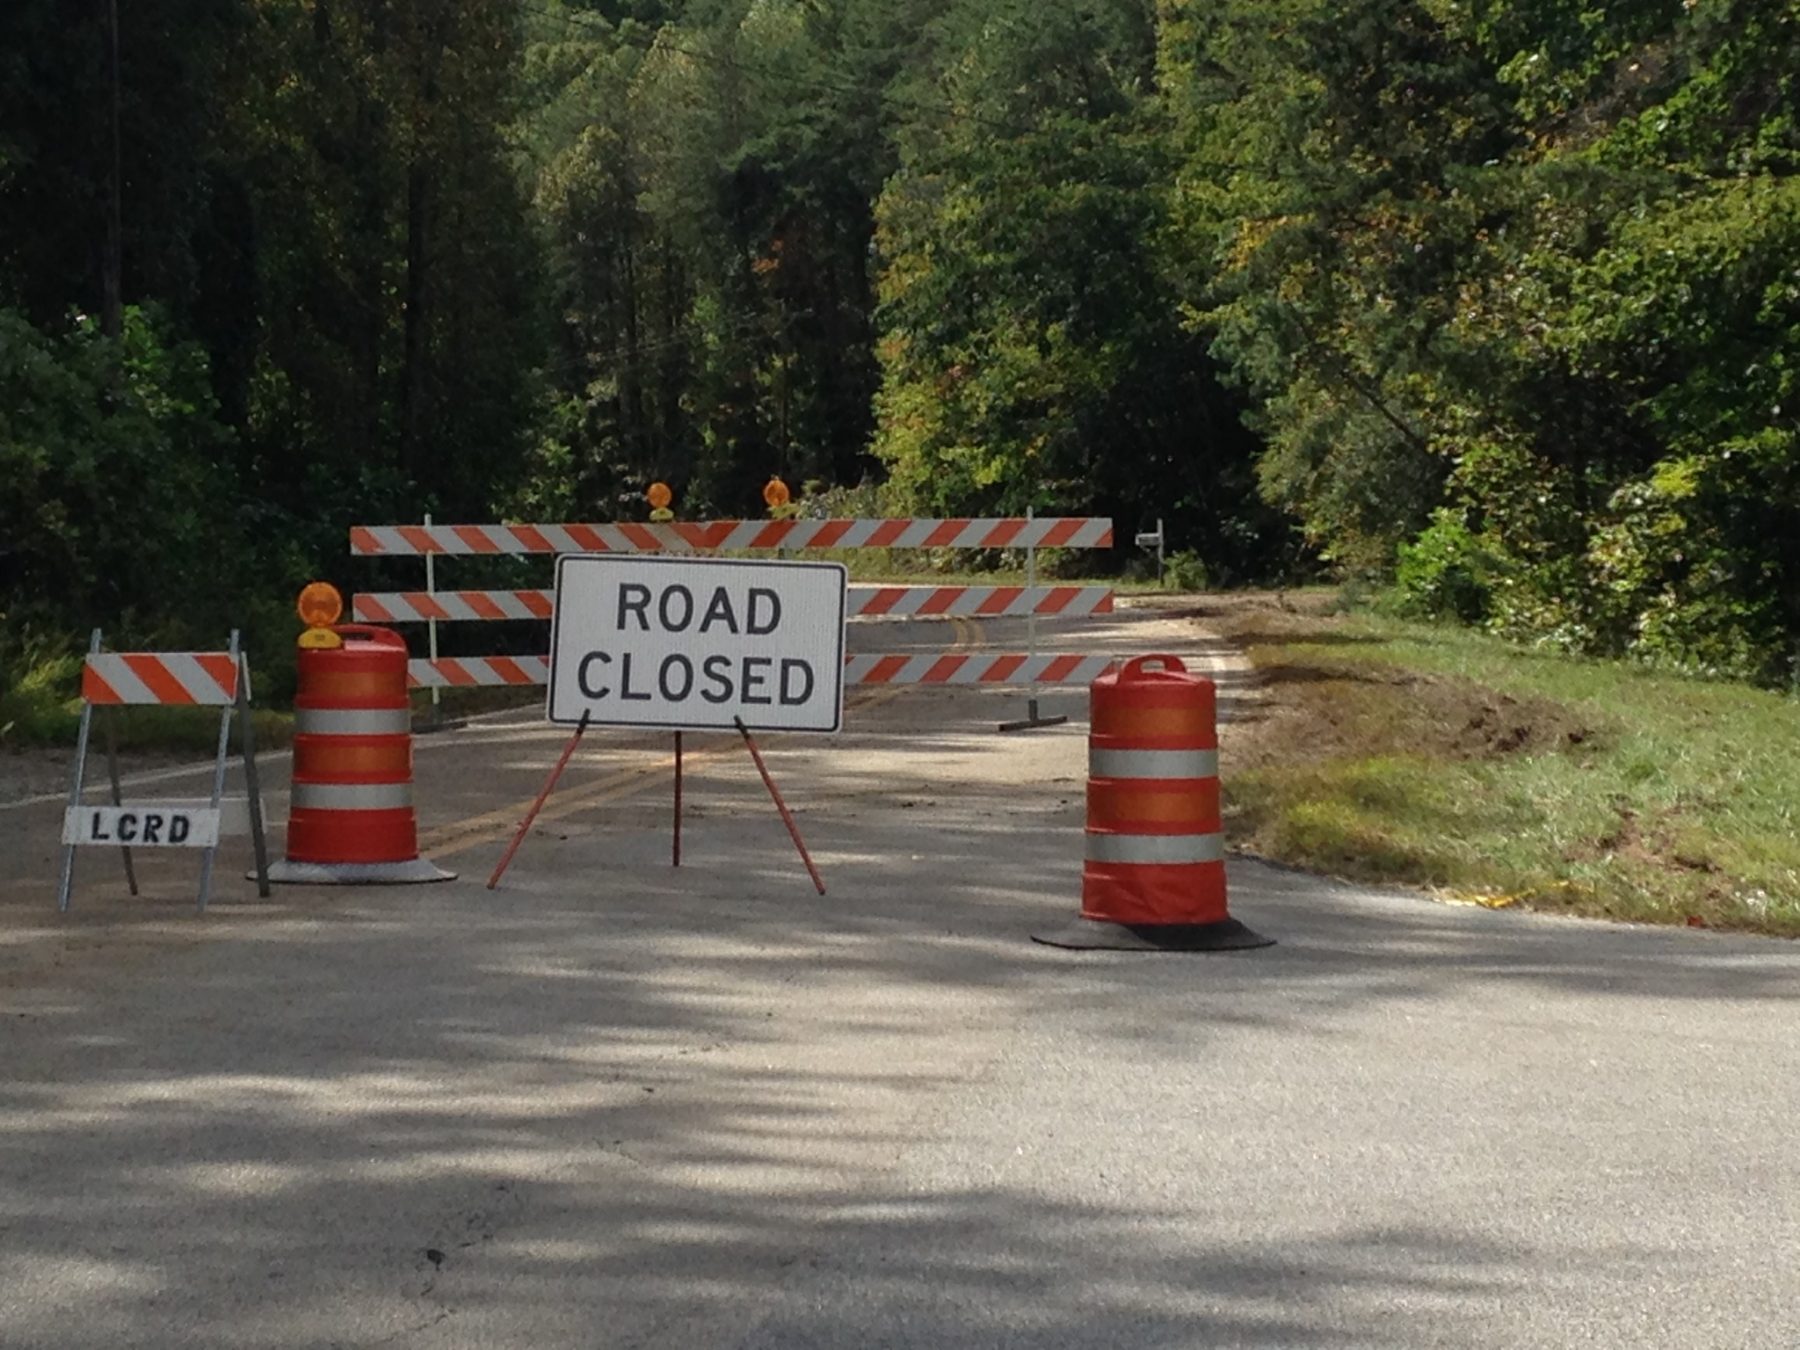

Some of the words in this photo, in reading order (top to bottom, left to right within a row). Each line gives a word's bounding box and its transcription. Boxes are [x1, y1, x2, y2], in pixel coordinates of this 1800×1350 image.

[617, 583, 782, 635] ROAD
[578, 651, 814, 705] CLOSED
[91, 812, 190, 843] LCRD
